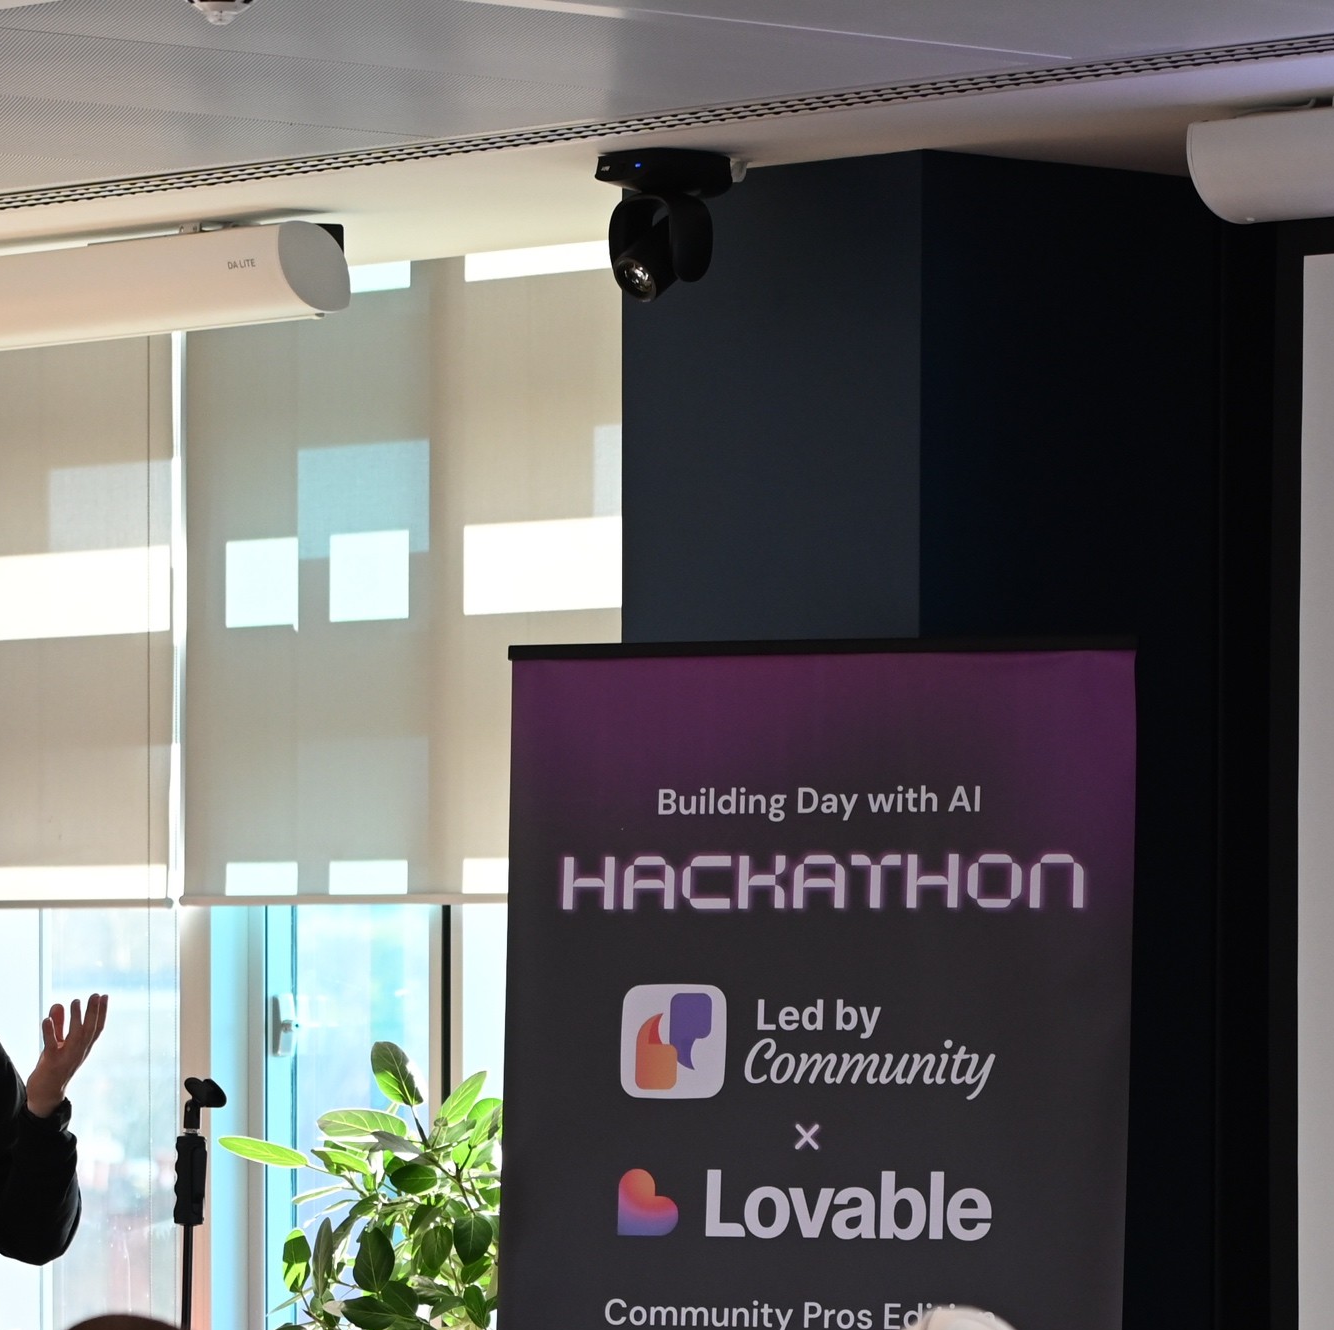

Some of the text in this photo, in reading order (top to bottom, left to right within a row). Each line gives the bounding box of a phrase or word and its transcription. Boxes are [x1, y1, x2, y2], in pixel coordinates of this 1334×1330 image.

[657, 785, 981, 821] Building Day with AI
[562, 853, 1085, 911] HACKATHON
[756, 998, 881, 1039] Led by
[743, 1038, 995, 1100] Community
[704, 1169, 992, 1241] Lovable
[803, 1302, 872, 1330] Pros
